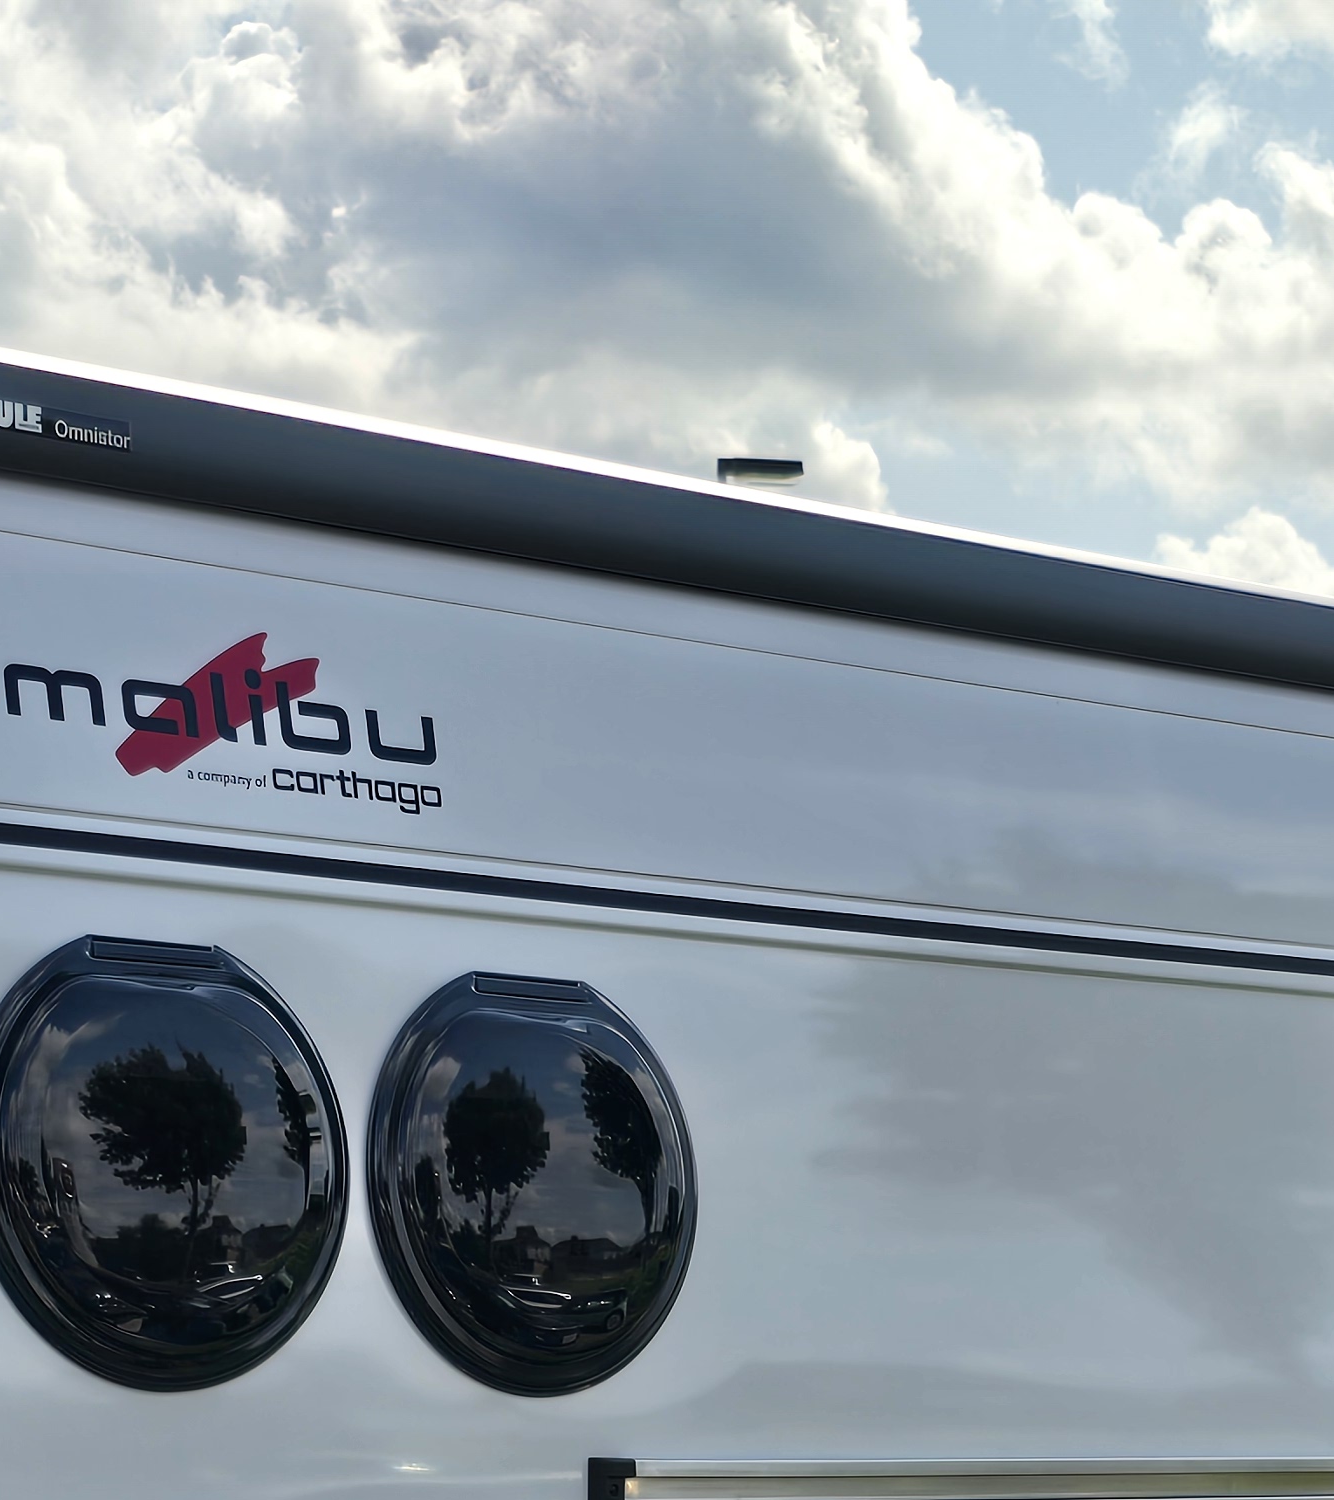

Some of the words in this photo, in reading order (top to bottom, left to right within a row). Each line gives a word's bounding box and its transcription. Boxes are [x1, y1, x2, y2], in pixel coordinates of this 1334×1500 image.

[54, 418, 131, 449] Omnistor
[3, 662, 437, 766] malibu
[272, 768, 443, 815] carthago
